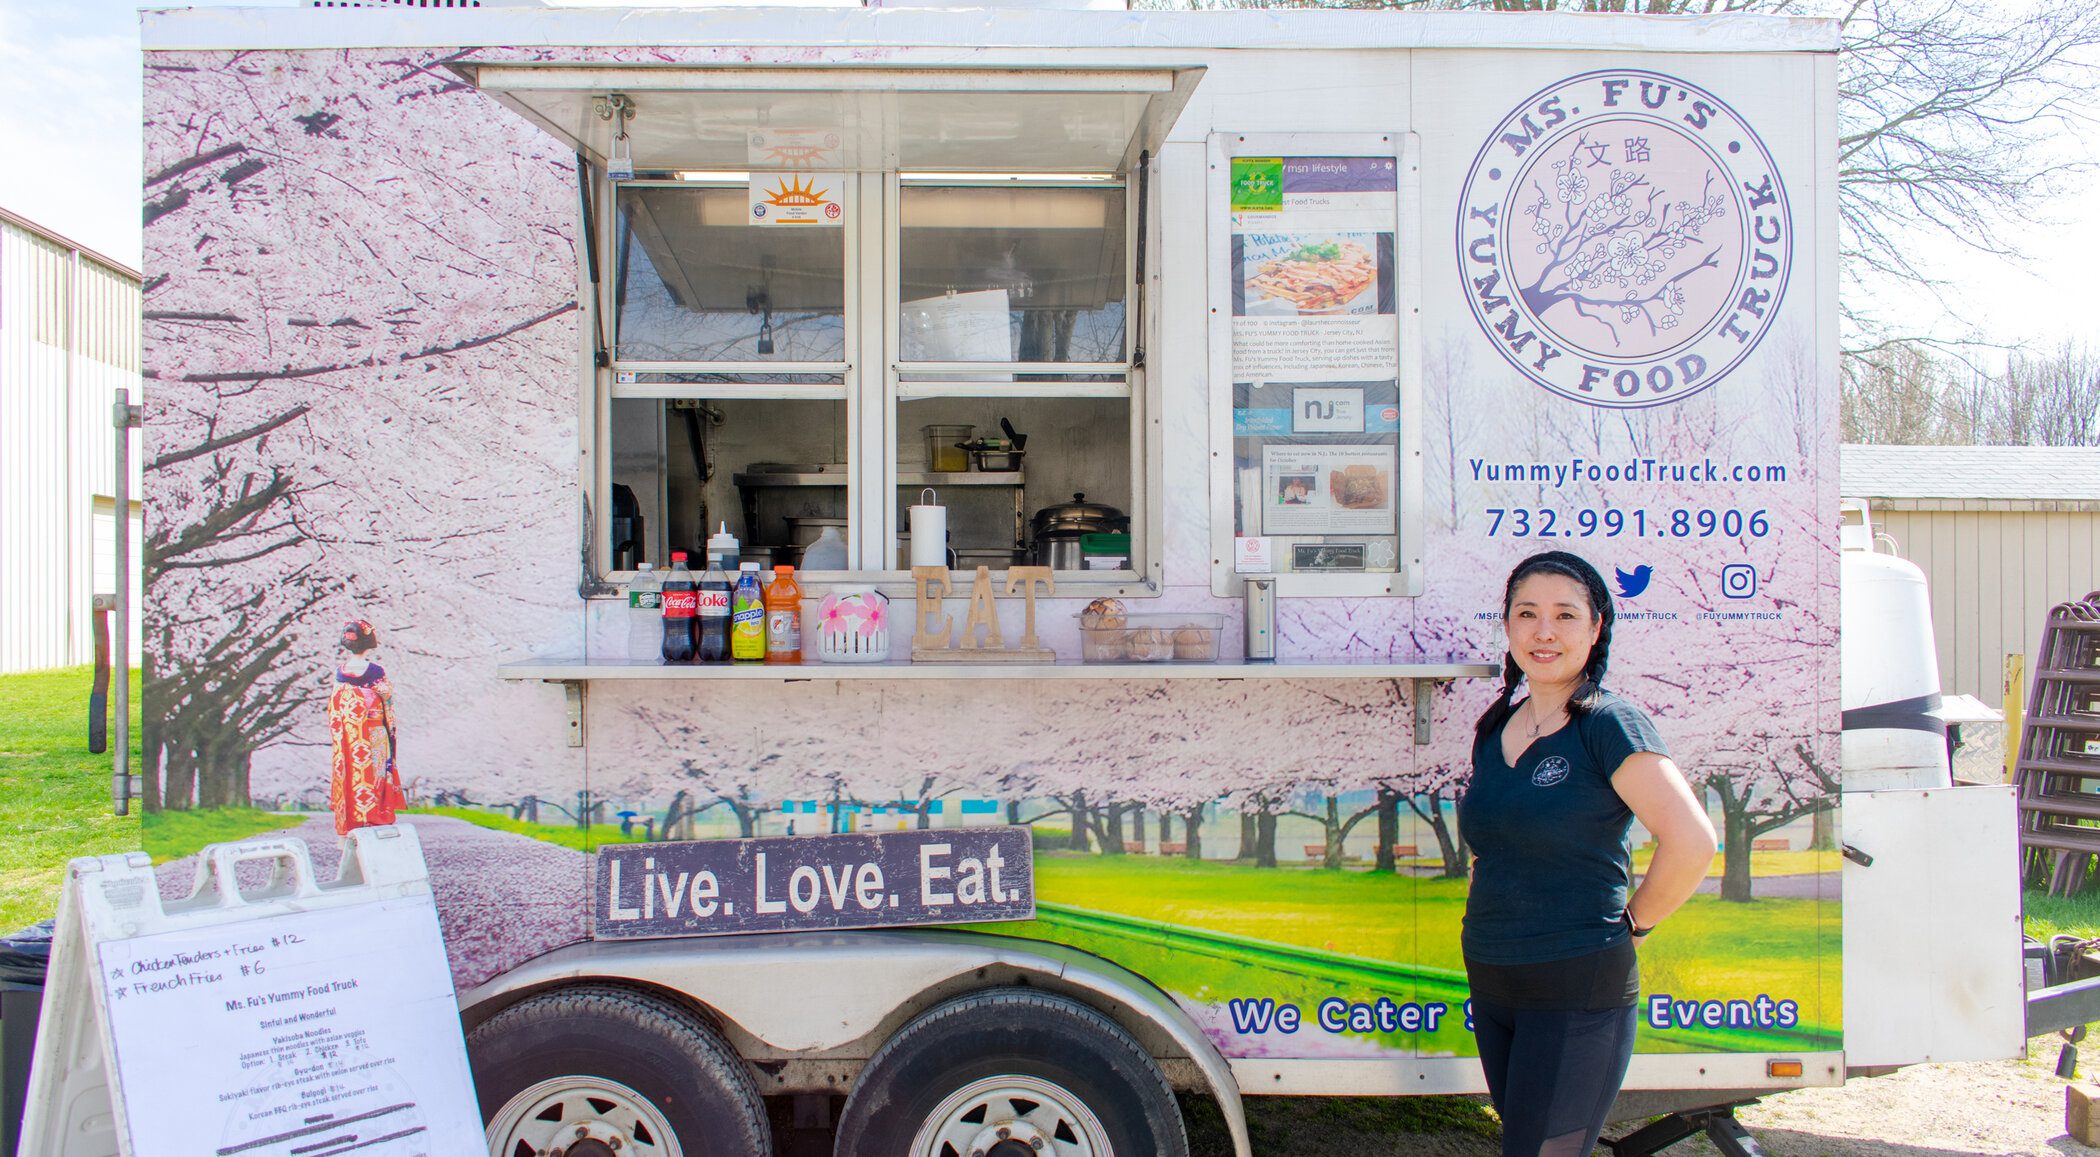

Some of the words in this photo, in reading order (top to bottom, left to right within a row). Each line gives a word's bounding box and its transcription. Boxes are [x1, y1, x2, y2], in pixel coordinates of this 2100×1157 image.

[1499, 95, 1580, 158] MS.
[1601, 79, 1717, 131] FU'S
[1583, 135, 1652, 169] 文路
[1287, 165, 1309, 173] msn
[1311, 163, 1348, 175] lifestyle
[1291, 198, 1309, 206] Food
[1309, 198, 1330, 206] Trucks
[1467, 201, 1561, 374] YUMMY
[1577, 352, 1709, 397] FOOD
[1717, 173, 1783, 345] TRUCK
[1268, 320, 1298, 328] Instagram
[1289, 340, 1321, 348] comforting
[1291, 348, 1309, 356] Jersey
[1346, 347, 1357, 355] get
[1257, 356, 1279, 364] Yummy
[1378, 354, 1392, 362] tasty
[1283, 363, 1309, 371] including
[1245, 371, 1273, 379] American.
[1468, 458, 1787, 489] YummyFoodTruck.com
[1485, 508, 1769, 538] 732.991.8906
[697, 592, 729, 608] Coke
[911, 565, 1056, 649] EAT
[749, 619, 760, 627] tea
[1695, 612, 1782, 621] @FUYUMMYTRUCK
[608, 856, 734, 922] Live.
[755, 852, 900, 916] Love.
[919, 842, 1021, 907] Eat.
[231, 943, 265, 957] Fries
[225, 1000, 246, 1012] Ms.
[246, 995, 267, 1008] Fu's
[267, 989, 306, 1004] Yummy
[306, 982, 330, 997] Food
[330, 978, 359, 992] Truck
[259, 1013, 283, 1029] Sinful
[283, 1014, 298, 1025] and
[298, 1006, 337, 1022] Wonderful
[1230, 998, 1302, 1034] We
[1319, 997, 1449, 1034] Cater
[1647, 994, 1800, 1030] Events
[239, 1048, 270, 1062] Japanese
[270, 1044, 285, 1055] thin
[284, 1040, 309, 1052] noodles
[309, 1036, 326, 1048] with
[325, 1033, 344, 1043] asian
[343, 1028, 366, 1041] veggies
[272, 1031, 305, 1045] Yakisoba
[304, 1026, 332, 1039] Noodles
[277, 1051, 297, 1062] Steak
[313, 1042, 340, 1054] Chicken
[353, 1037, 367, 1046] Tofu
[218, 1089, 250, 1103] Sukiyaki
[249, 1084, 271, 1097] flavor
[271, 1080, 296, 1093] rib-eye
[295, 1075, 315, 1086] steak
[314, 1070, 331, 1081] with
[348, 1062, 370, 1074] served
[369, 1060, 384, 1070] over
[383, 1055, 396, 1066] rice
[248, 1108, 273, 1121] Korean
[273, 1104, 288, 1115] BBQ
[312, 1094, 332, 1106] steak
[331, 1089, 352, 1102] served
[351, 1087, 367, 1097] over
[366, 1083, 379, 1094] rice
